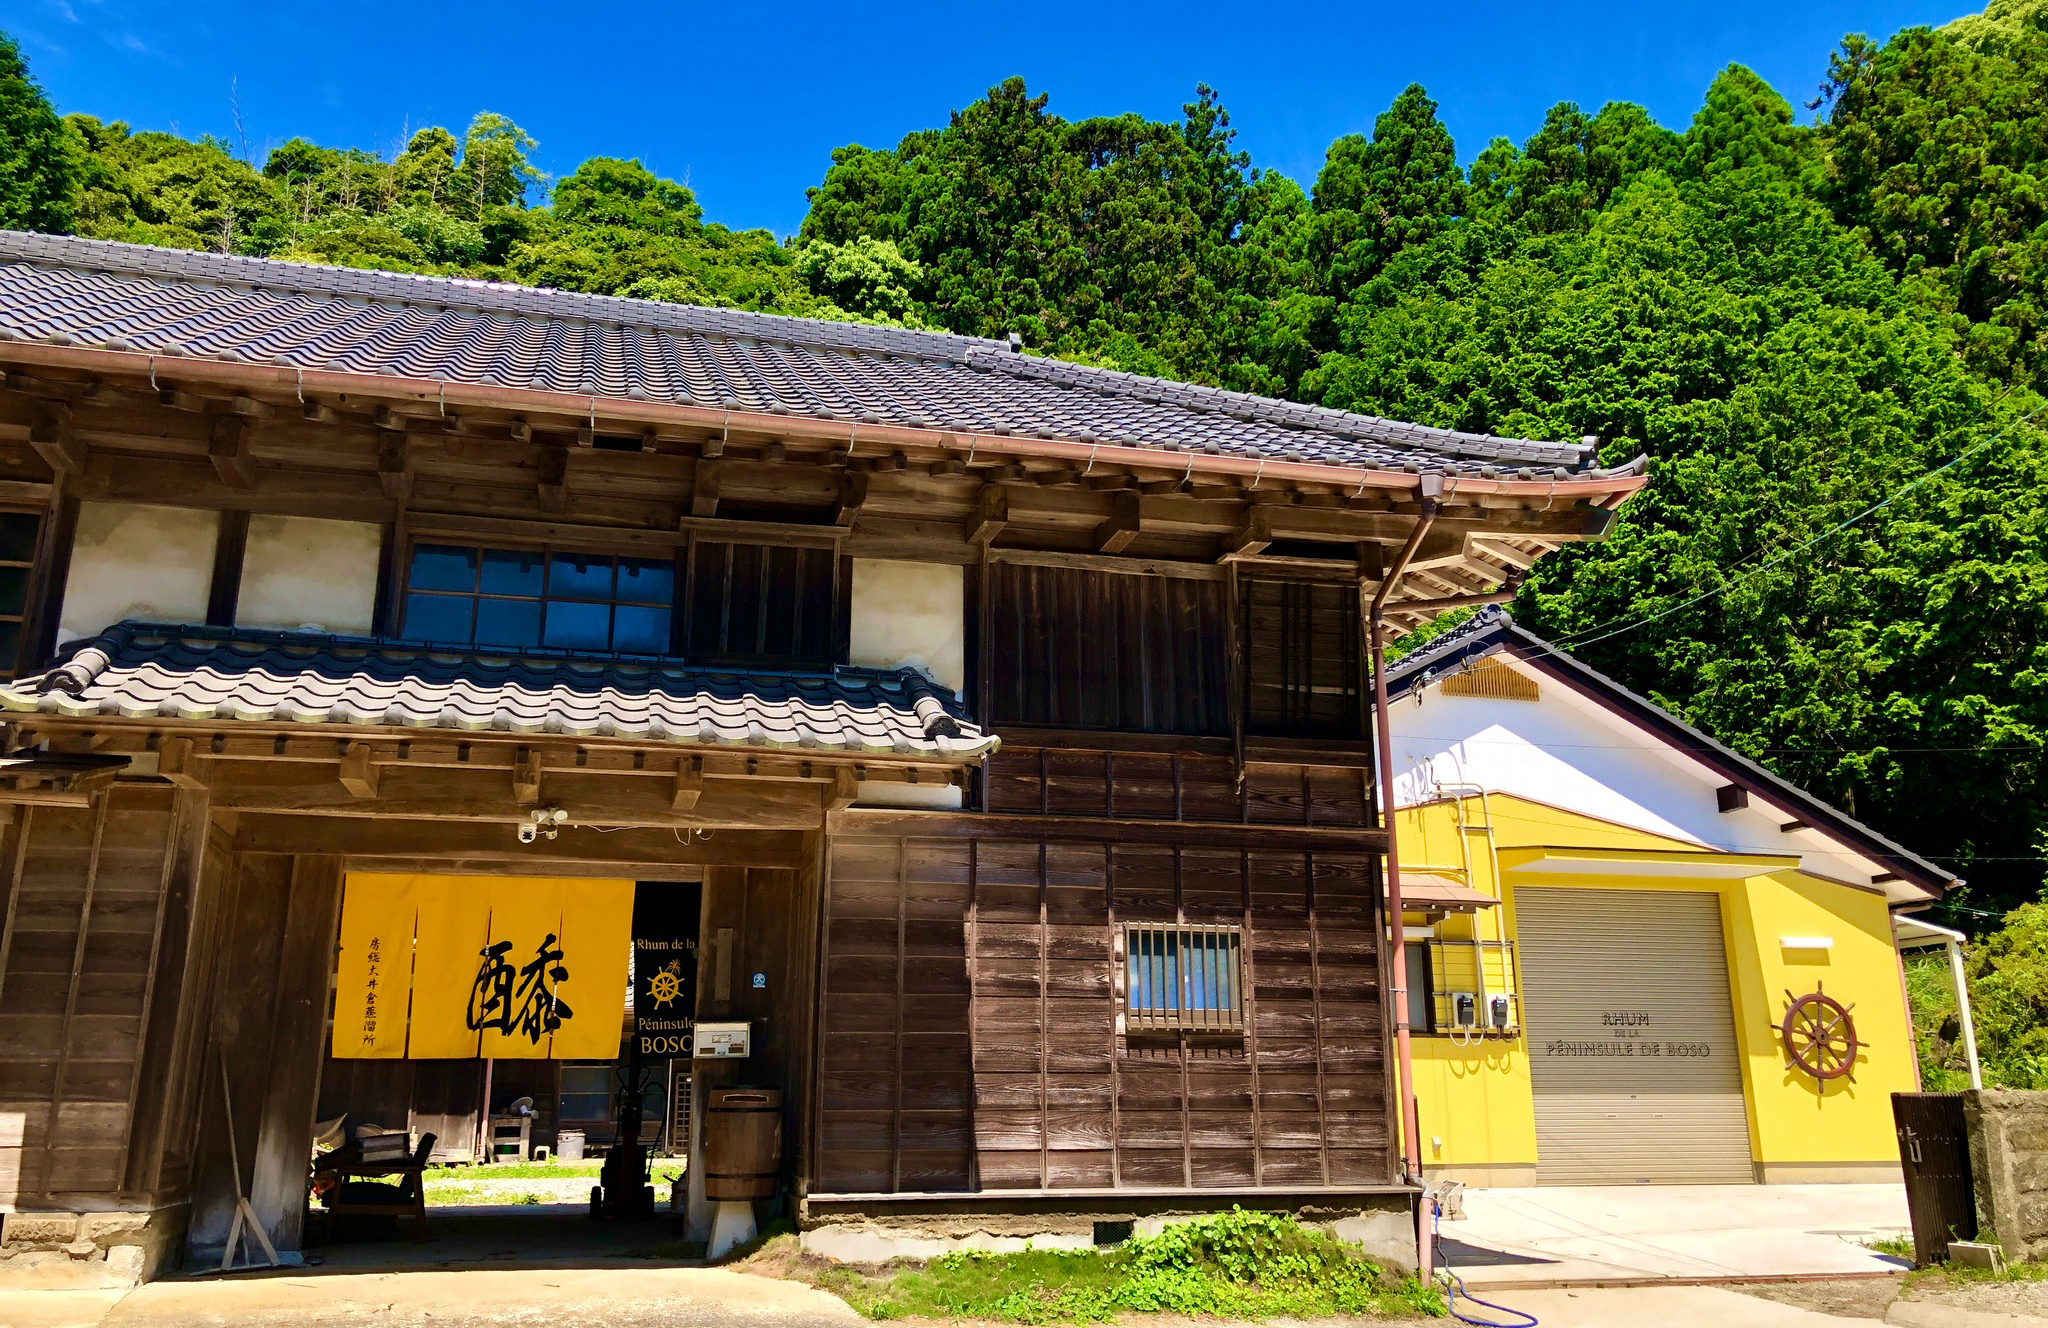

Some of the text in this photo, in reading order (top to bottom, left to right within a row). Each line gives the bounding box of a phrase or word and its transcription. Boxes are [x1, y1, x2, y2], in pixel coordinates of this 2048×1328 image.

[637, 938, 696, 950] Rhum de la
[1601, 1012, 1650, 1026] RHUM
[1629, 1030, 1641, 1038] LA
[1546, 1040, 1711, 1057] PÉNINSULE DE BOSO
